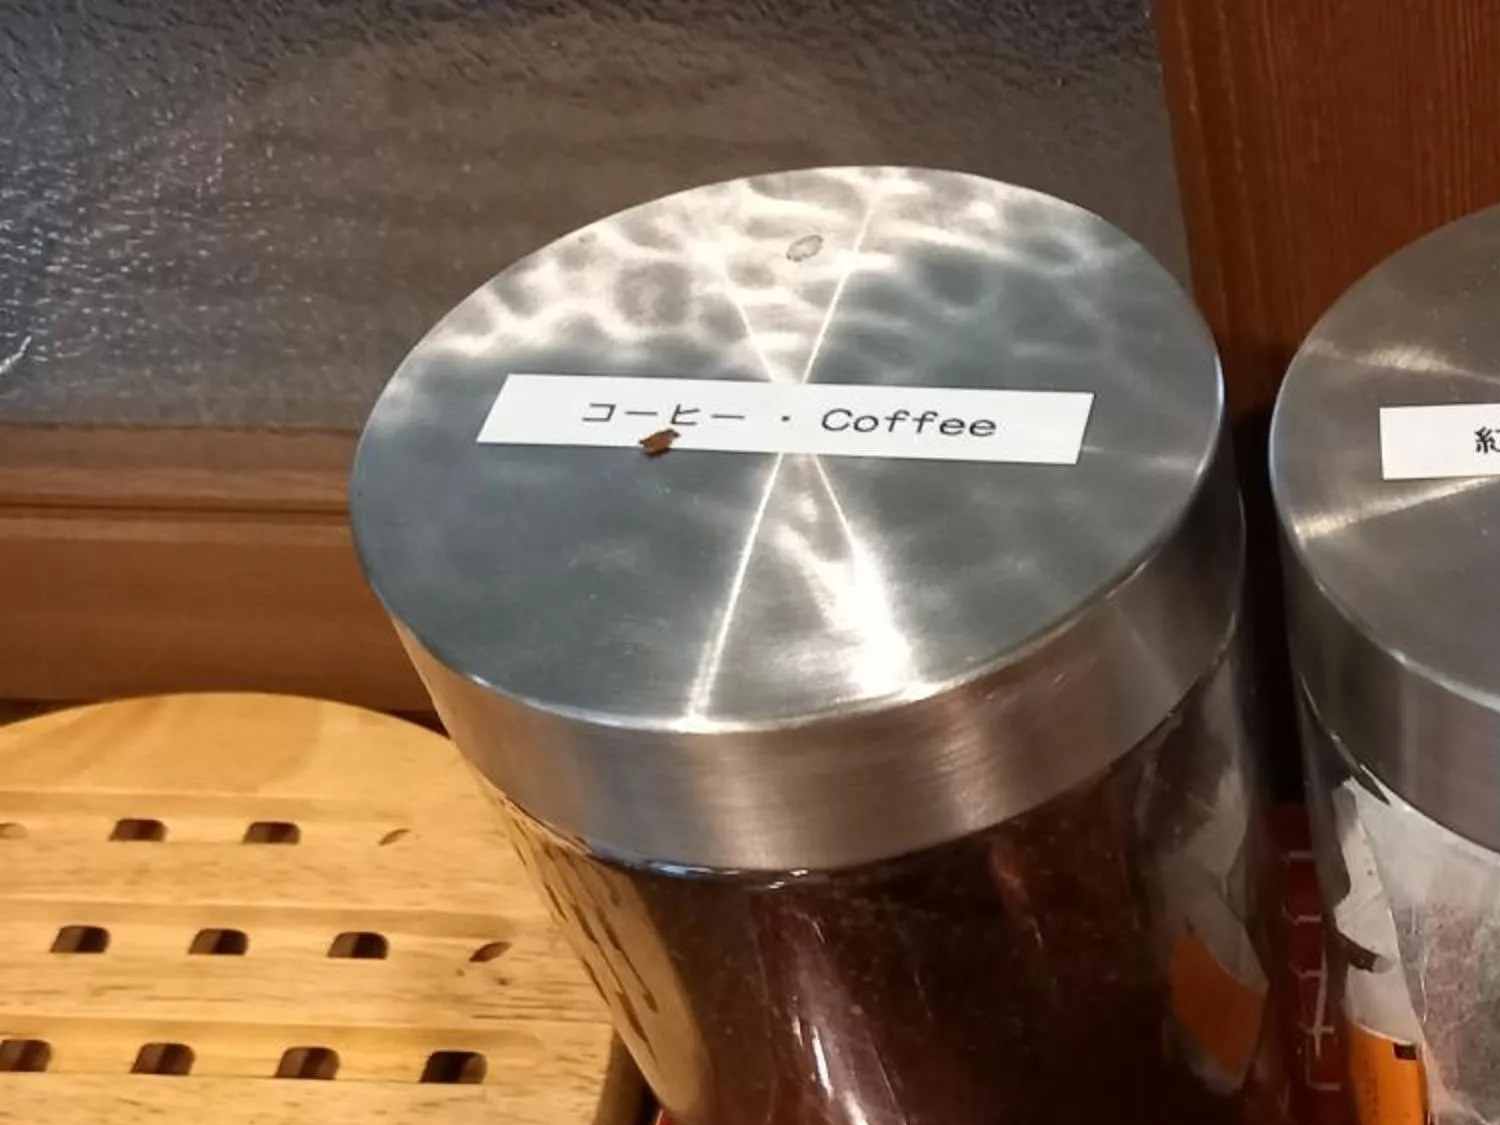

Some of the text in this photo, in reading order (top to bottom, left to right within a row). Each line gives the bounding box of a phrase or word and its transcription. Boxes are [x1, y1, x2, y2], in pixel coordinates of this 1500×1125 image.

[581, 402, 746, 426] コーヒー
[820, 408, 998, 438] Coffee
